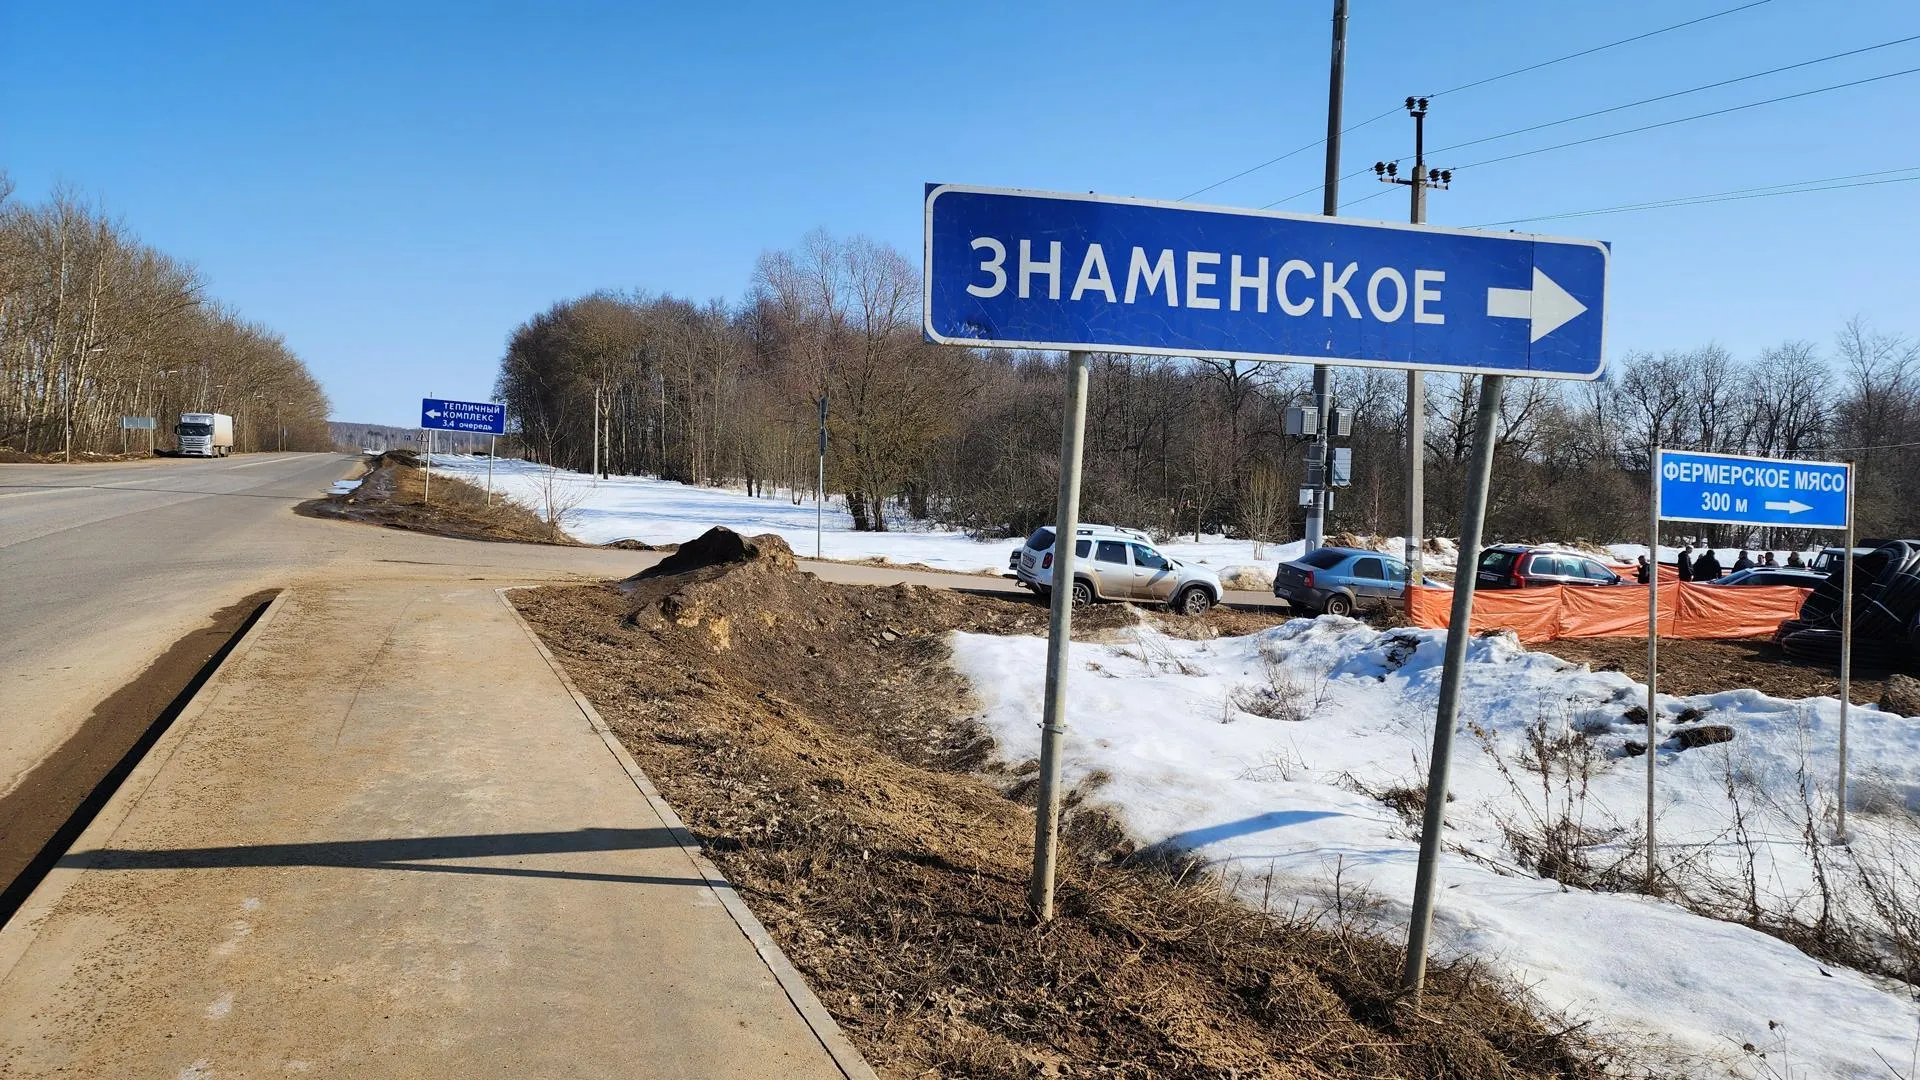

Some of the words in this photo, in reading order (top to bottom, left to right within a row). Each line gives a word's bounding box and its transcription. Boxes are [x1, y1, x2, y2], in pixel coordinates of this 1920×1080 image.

[966, 236, 1446, 325] ЗНАМЕНСКОЕ
[443, 402, 500, 414] ТЕПЛИЧНЫЙ
[443, 411, 494, 422] КОМПЛЕКС
[459, 422, 493, 431] очередь
[1663, 461, 1790, 489] ФЕРМЕРСКОЕ
[1794, 471, 1845, 493] МЯСО
[1701, 492, 1731, 512] 300
[1735, 498, 1748, 513] м
